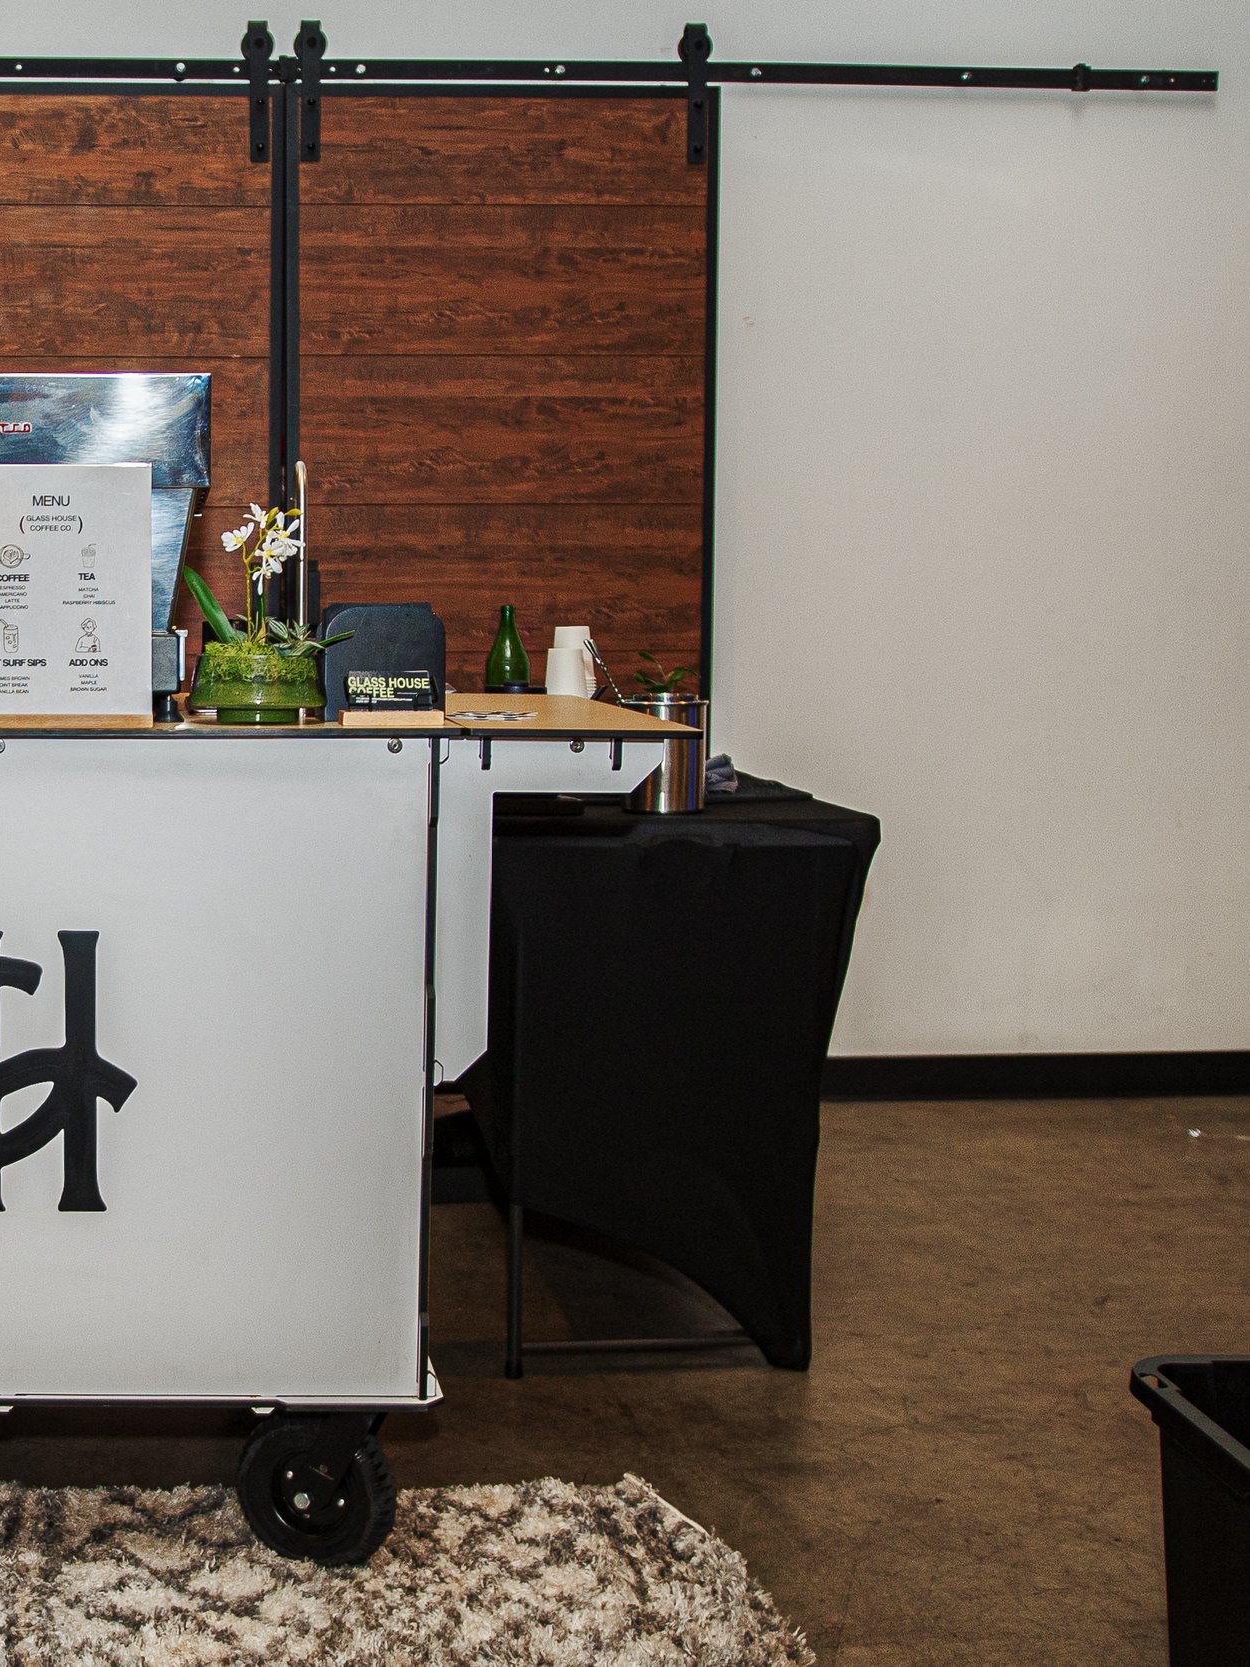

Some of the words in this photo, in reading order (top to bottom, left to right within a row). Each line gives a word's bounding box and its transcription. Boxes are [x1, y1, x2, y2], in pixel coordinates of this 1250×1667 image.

[32, 495, 71, 507] MENU
[78, 573, 95, 581] TEA
[2, 659, 26, 667] SURF
[27, 659, 47, 667] SIPS
[68, 658, 88, 667] ADD
[88, 658, 109, 667] ONS
[347, 676, 386, 688] GLASS
[388, 677, 431, 689] HOUSE
[348, 687, 395, 698] COFFEE
